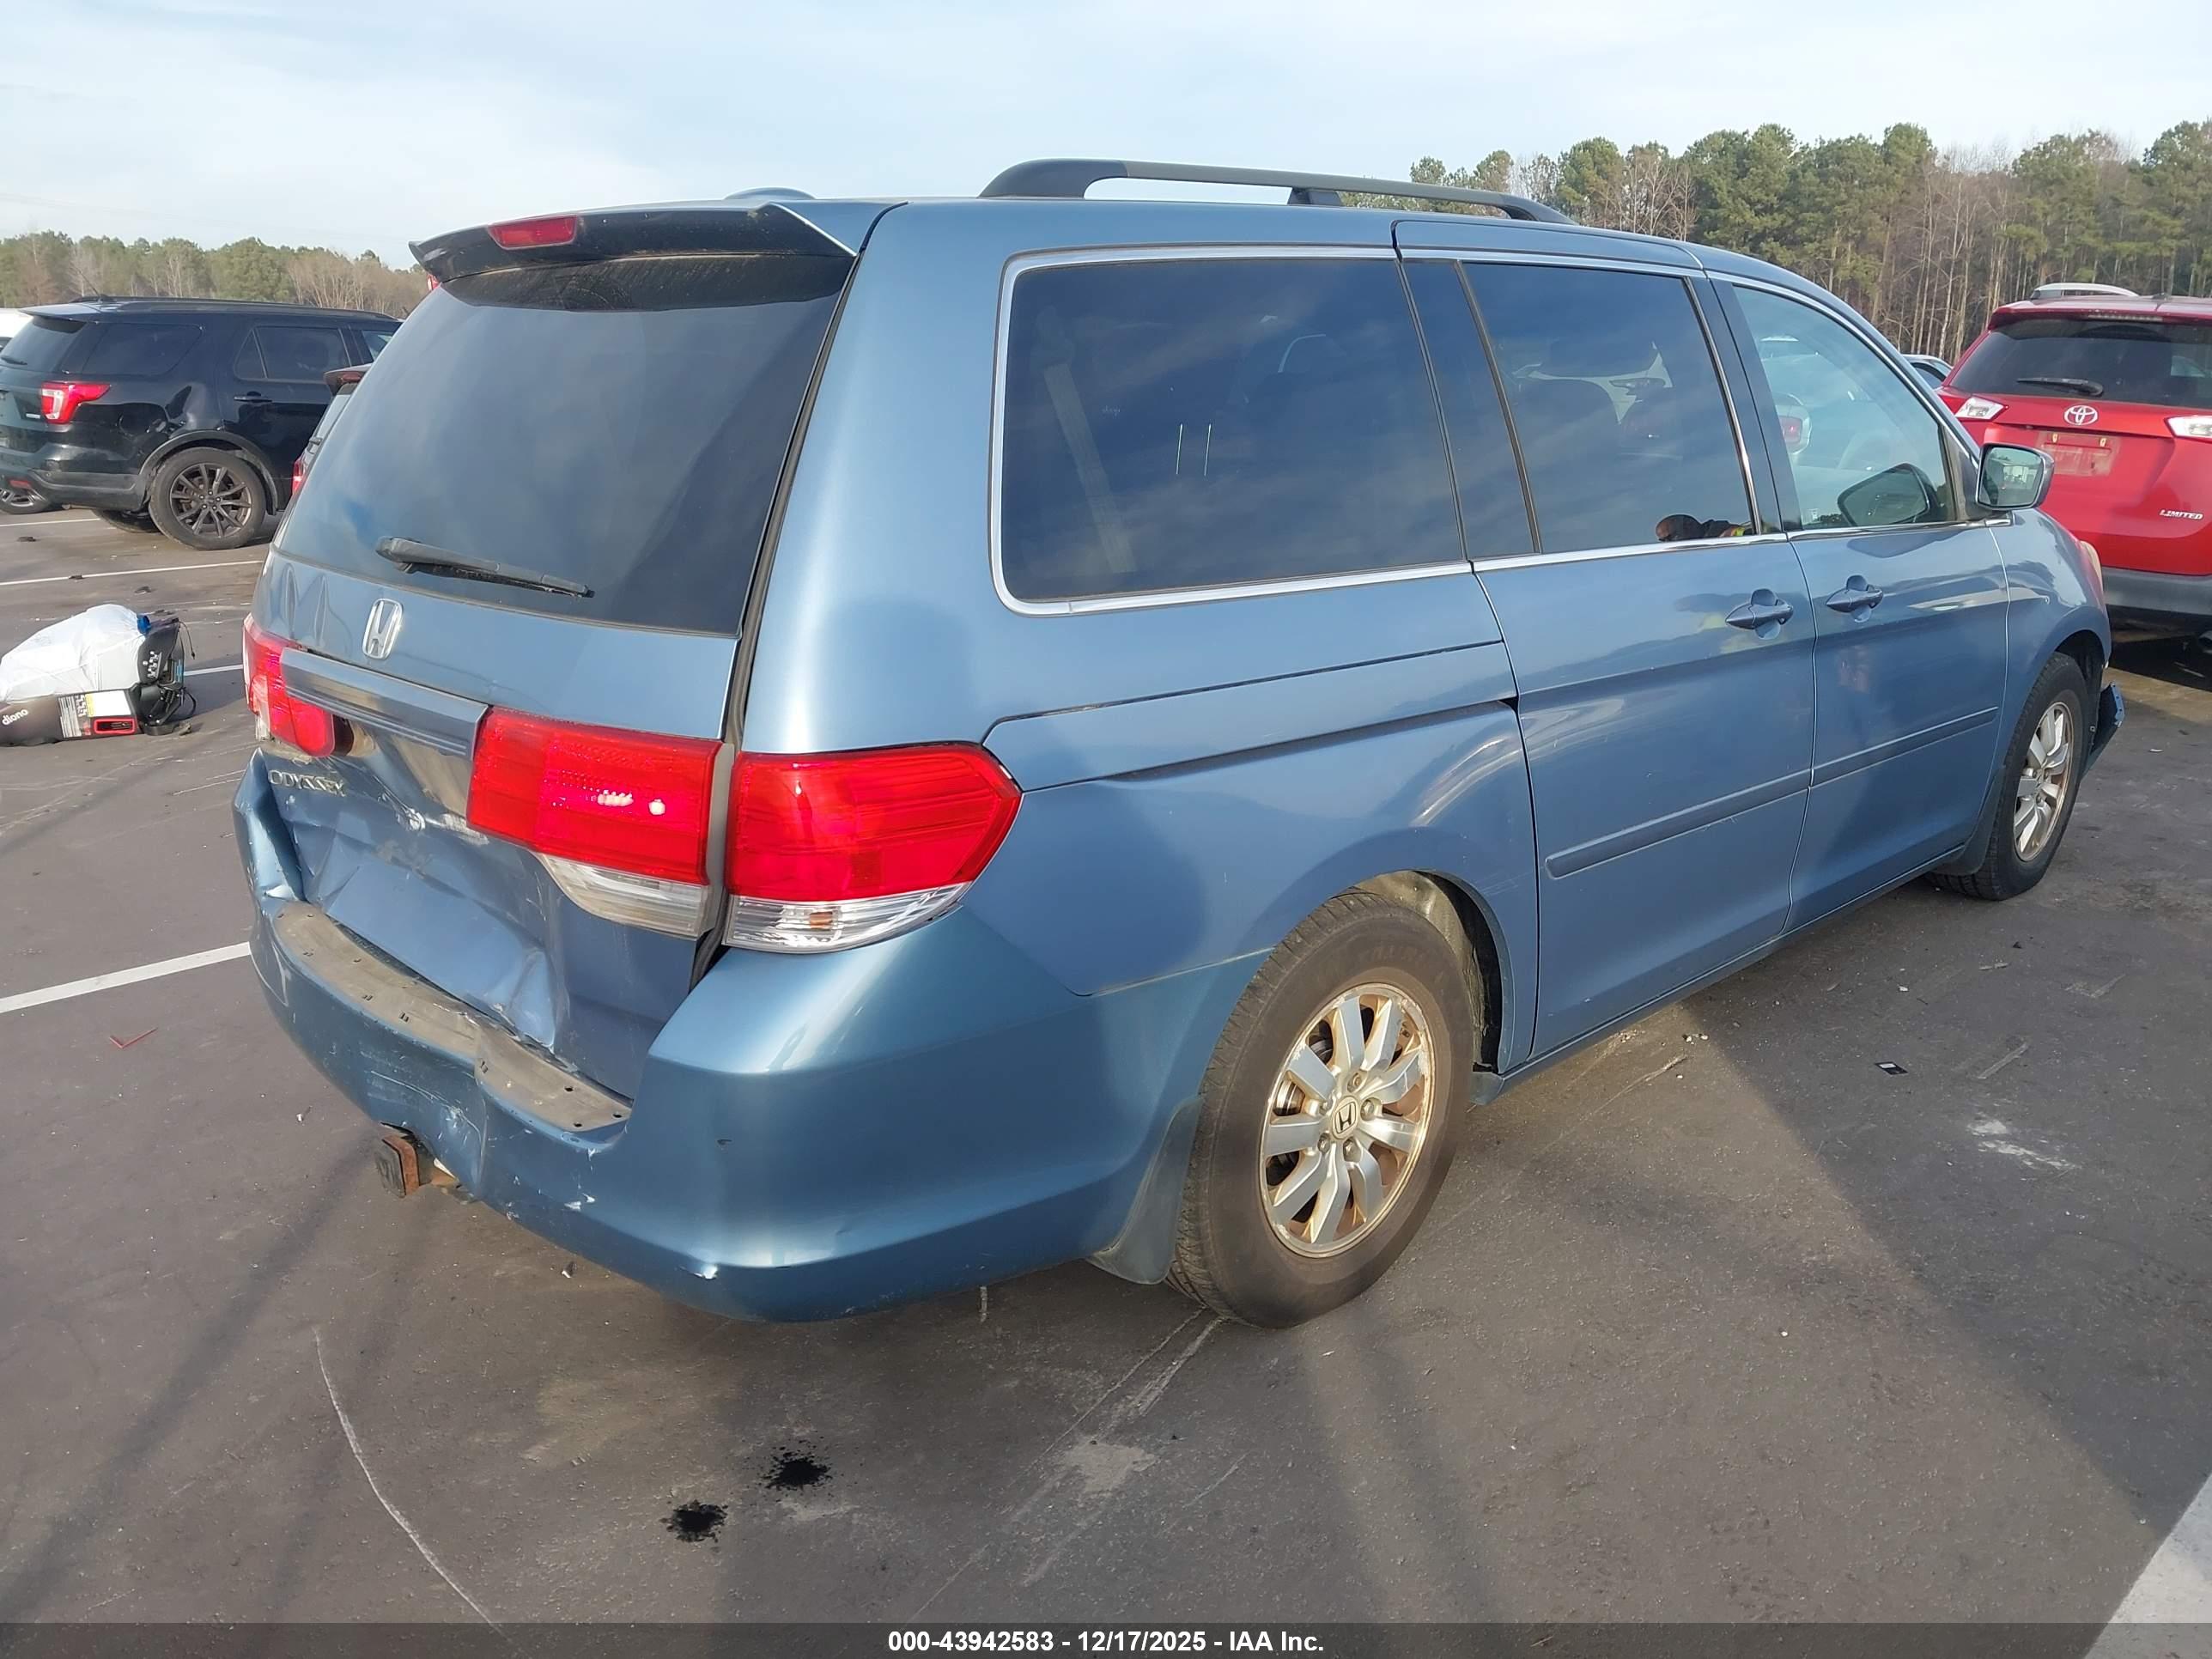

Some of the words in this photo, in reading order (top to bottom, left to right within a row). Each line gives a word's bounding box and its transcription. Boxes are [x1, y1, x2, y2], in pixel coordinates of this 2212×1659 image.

[2159, 509, 2203, 520] LIMITED
[2, 709, 28, 726] diono
[268, 769, 346, 797] ODYSSEY
